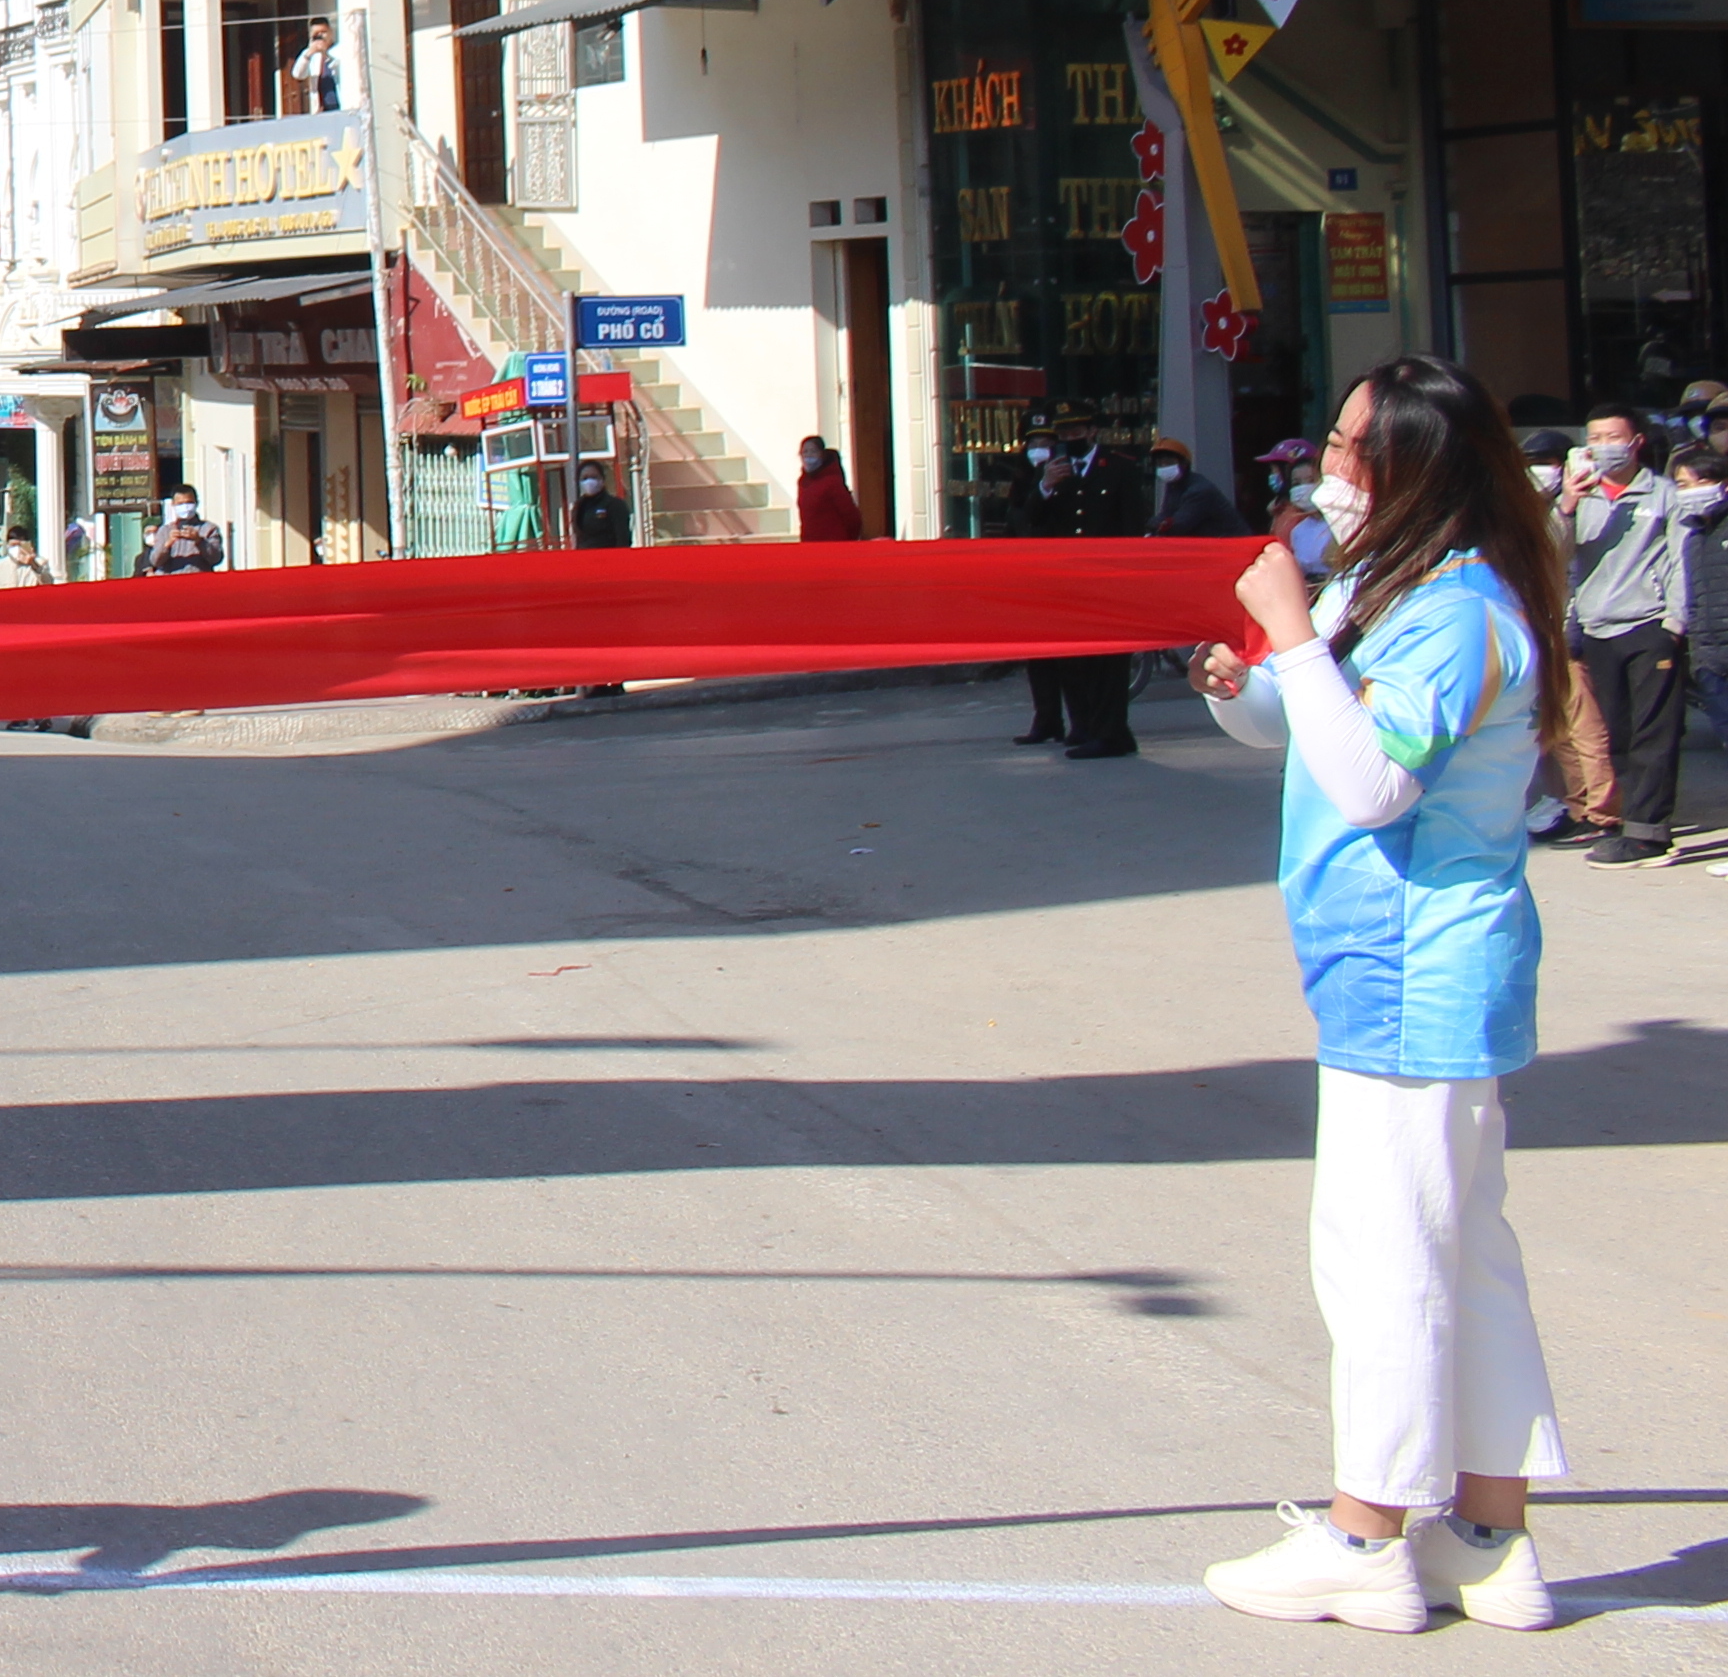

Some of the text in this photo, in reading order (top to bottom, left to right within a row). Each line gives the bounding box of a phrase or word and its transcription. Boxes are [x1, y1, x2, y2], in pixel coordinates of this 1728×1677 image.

[932, 58, 1022, 134] KHÁCH
[233, 135, 338, 206] HOTEL
[596, 304, 663, 316] ĐƯỜNG (ROAD)
[598, 317, 635, 340] PHỐ
[257, 322, 309, 365] TRÀ
